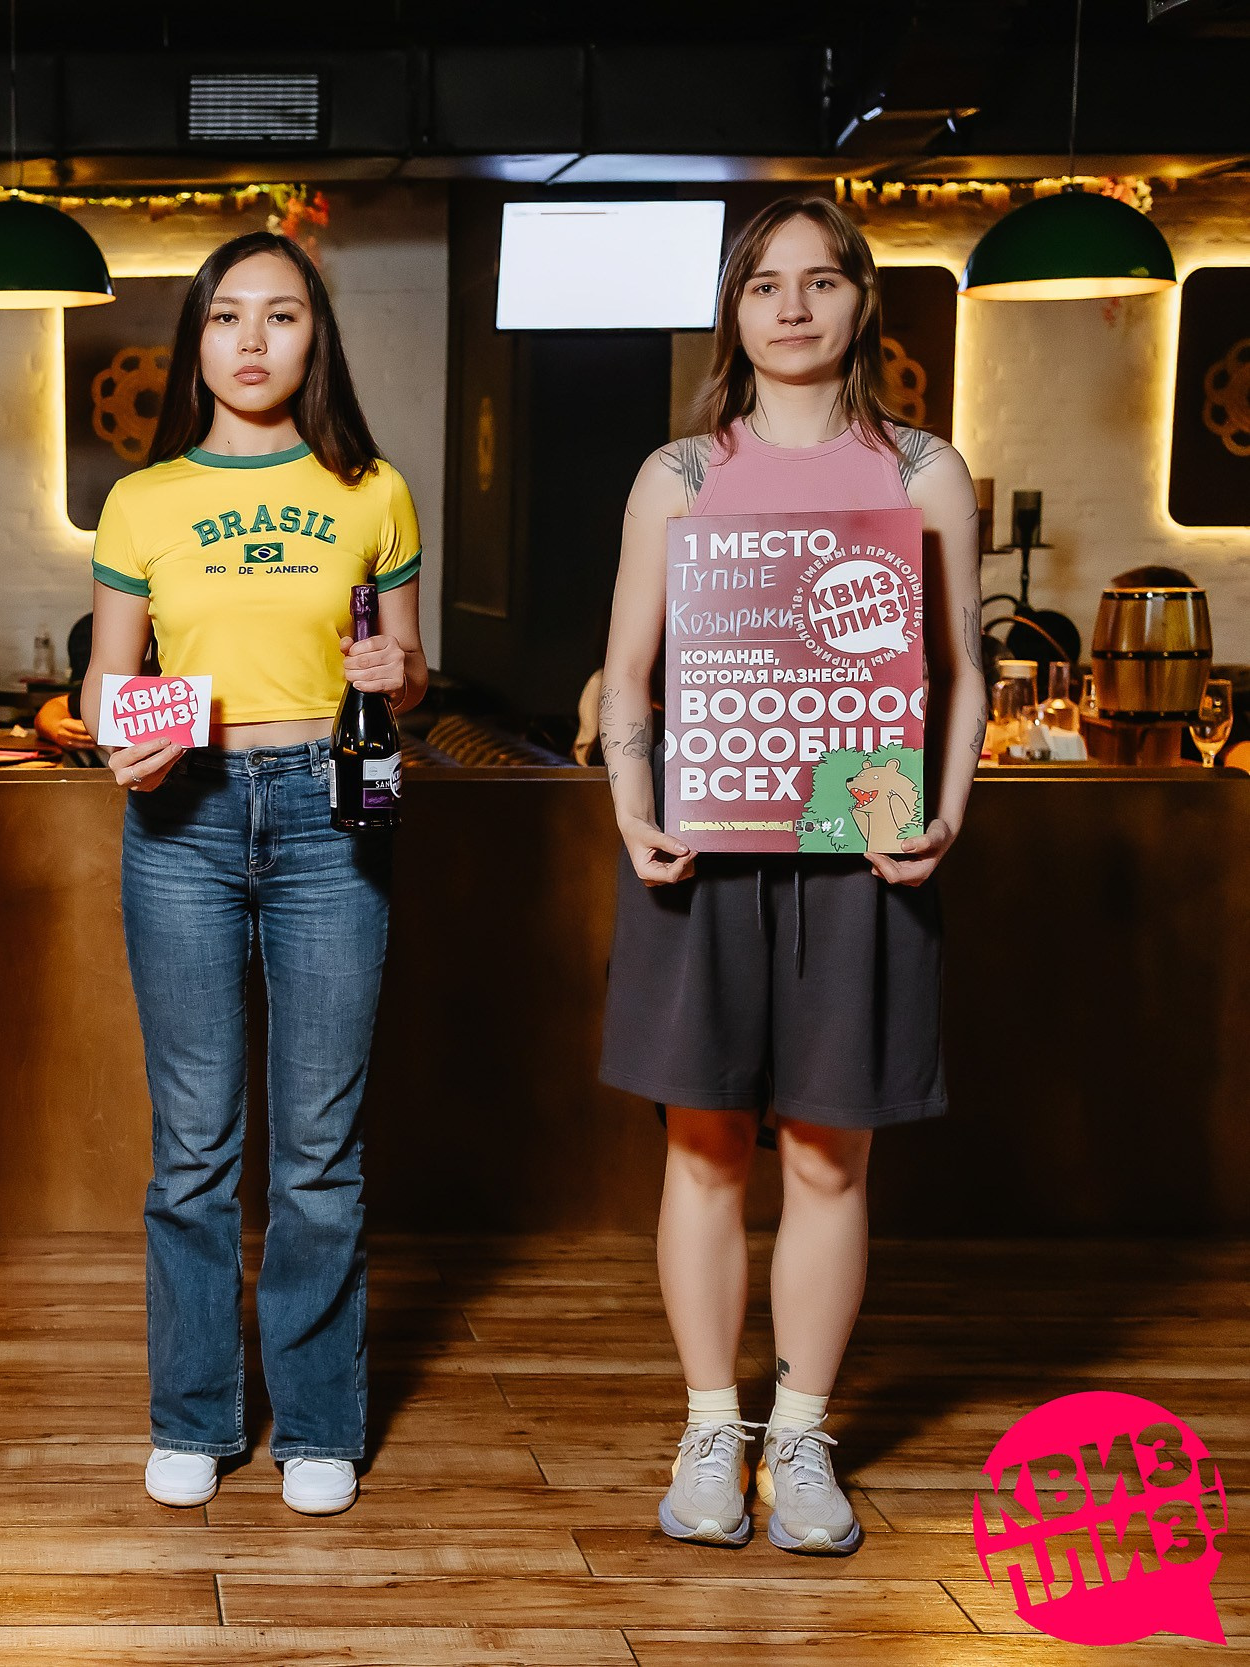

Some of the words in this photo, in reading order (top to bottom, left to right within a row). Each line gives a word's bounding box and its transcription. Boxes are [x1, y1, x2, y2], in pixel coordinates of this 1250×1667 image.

[192, 504, 337, 547] BRASIL
[683, 533, 698, 560] 1
[710, 529, 837, 560] МЕСТО
[851, 545, 861, 554] И
[205, 565, 227, 574] RIO
[238, 566, 254, 575] DE
[265, 565, 319, 574] JANEIRO
[813, 595, 909, 642] ПЛИЗ!
[680, 649, 780, 666] КОМАНДЕ,
[680, 669, 769, 685] КОТОРАЯ
[772, 667, 873, 683] РАЗНЕСЛА
[116, 701, 199, 737] ПЛИЗ!
[680, 766, 802, 802] ВСЕХ
